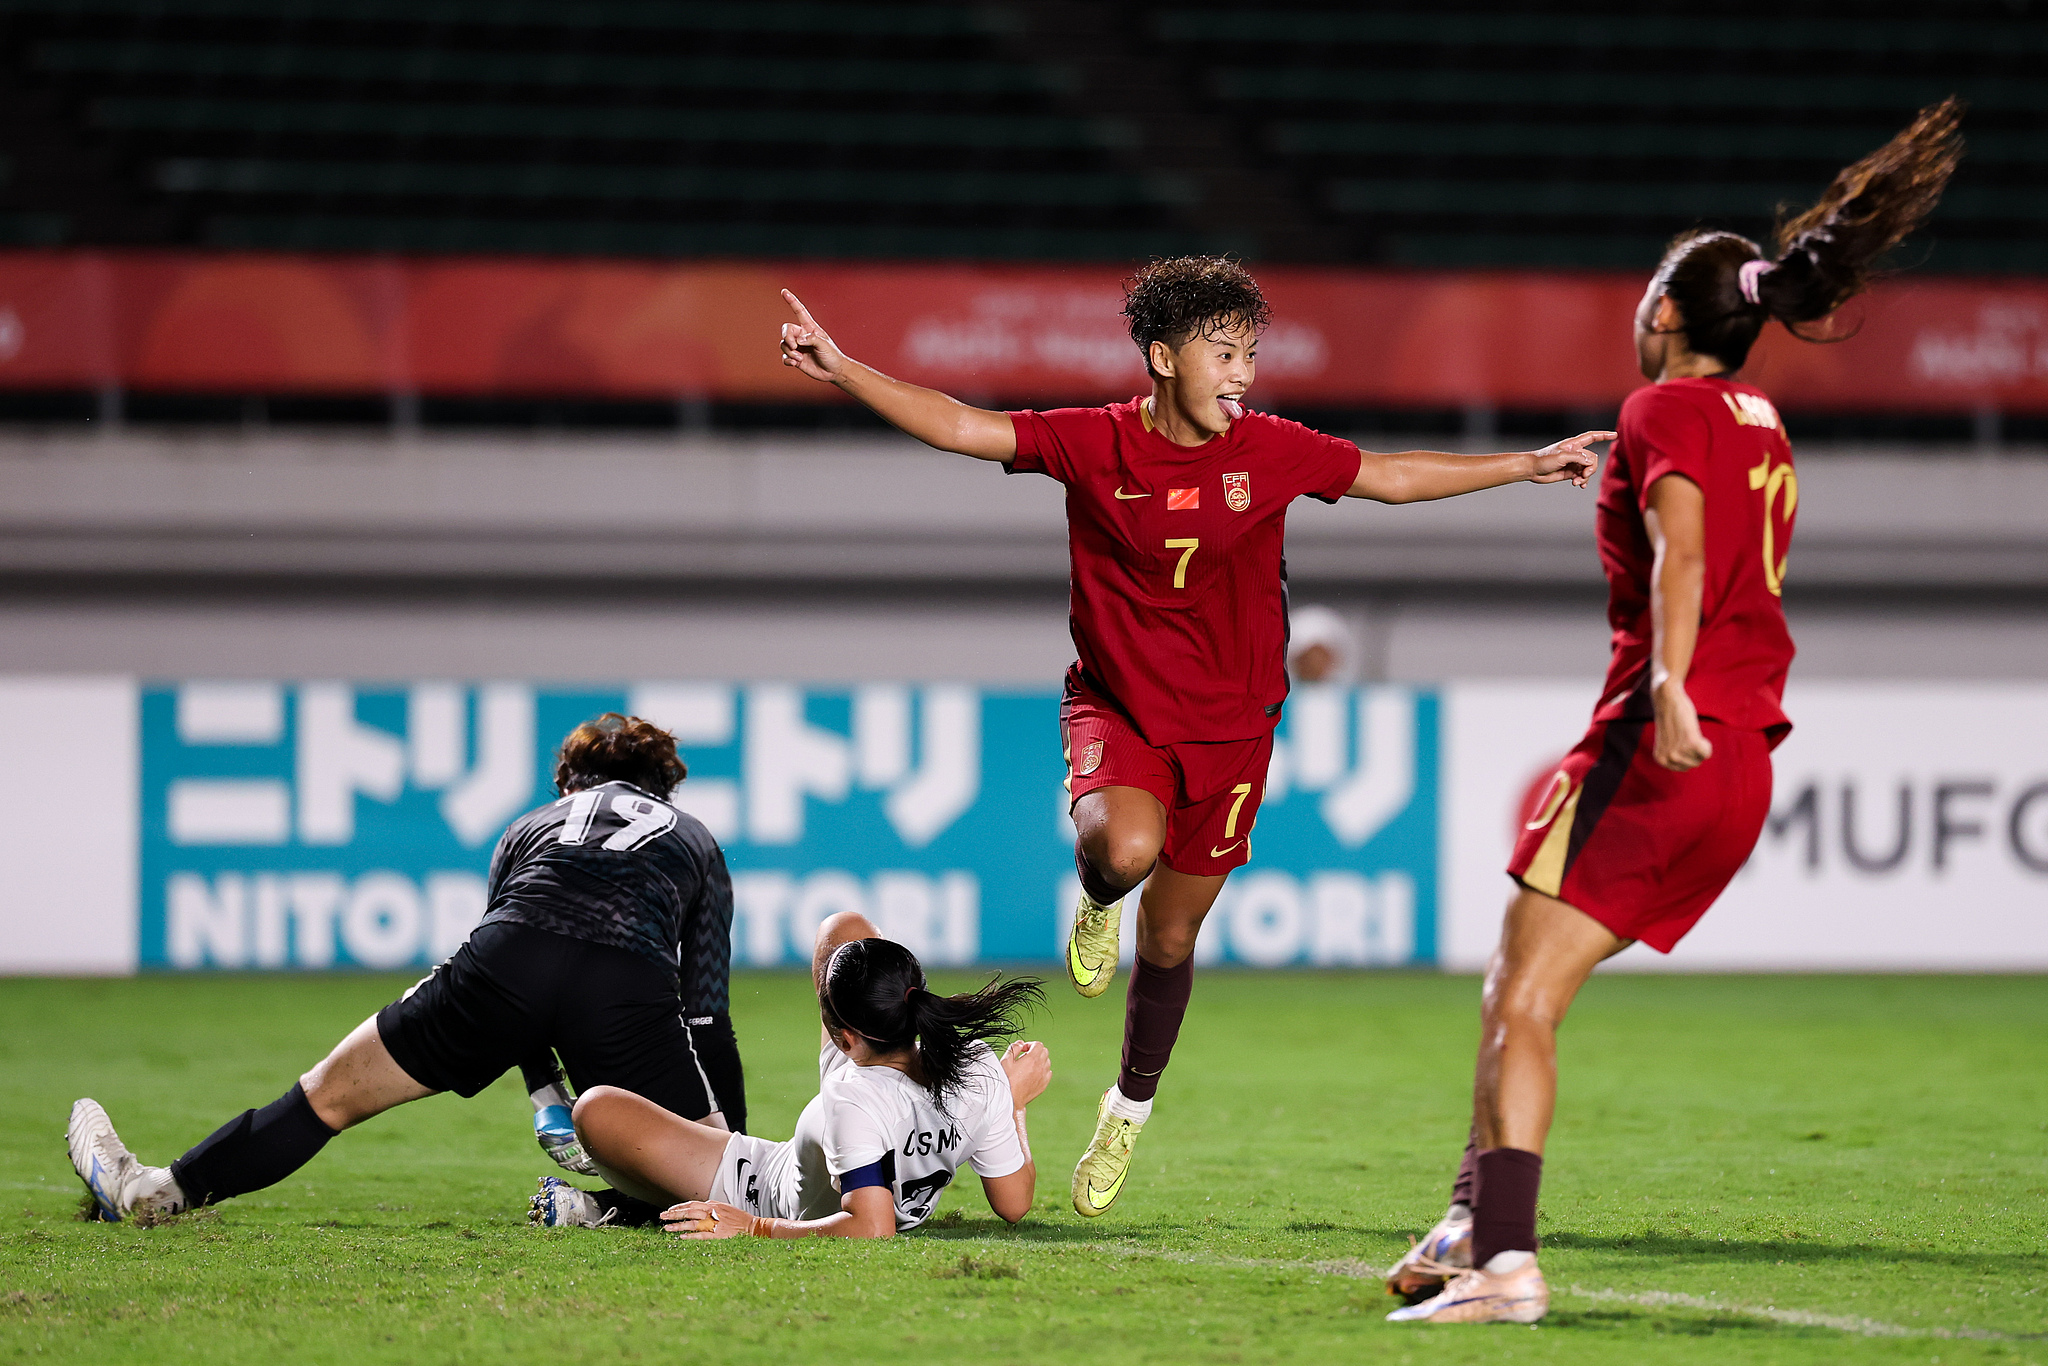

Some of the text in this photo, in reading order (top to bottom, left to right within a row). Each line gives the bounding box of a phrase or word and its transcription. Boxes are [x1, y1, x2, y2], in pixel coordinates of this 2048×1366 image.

[1225, 474, 1247, 484] CFA
[1165, 537, 1199, 588] 7
[169, 682, 536, 847] ニトリ
[630, 682, 982, 846] ニトリ
[555, 791, 678, 852] 19
[1224, 783, 1251, 839] 7
[168, 870, 492, 969] NITOR
[731, 868, 979, 968] TORI
